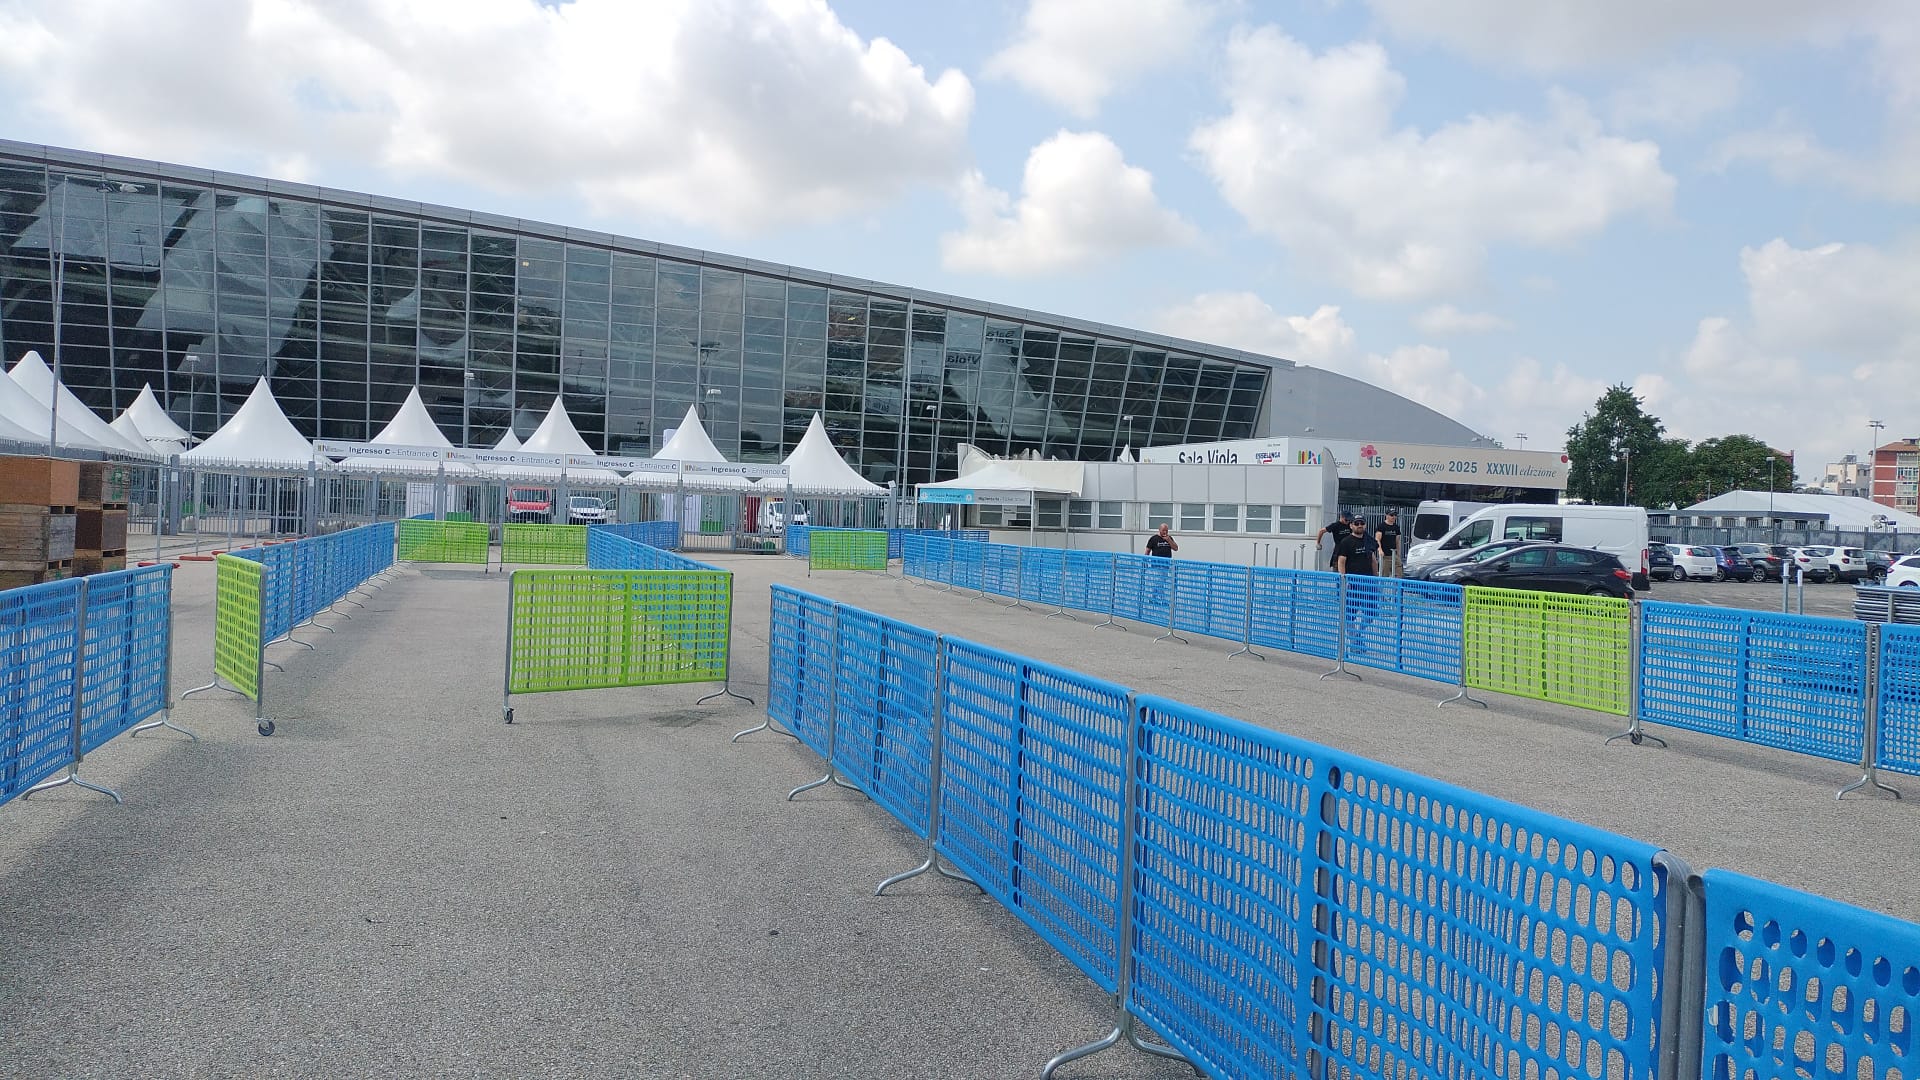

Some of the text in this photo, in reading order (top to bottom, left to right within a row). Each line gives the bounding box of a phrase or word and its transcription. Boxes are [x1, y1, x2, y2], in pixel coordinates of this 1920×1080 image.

[349, 446, 383, 455] Ingresso
[397, 449, 431, 458] Entrance
[432, 450, 438, 458] C
[1207, 448, 1238, 464] Viola
[475, 454, 508, 462] Ingresso
[521, 456, 554, 464] Entrance
[596, 460, 627, 468] Ingresso
[640, 461, 670, 469] Entrance
[711, 465, 740, 474] Ingresso
[1367, 456, 1382, 468] 15
[1392, 457, 1405, 470] 19
[1409, 460, 1445, 475] maggio
[1449, 460, 1478, 474] 2025
[1486, 462, 1518, 476] XXXVII
[1519, 464, 1556, 478] edizione
